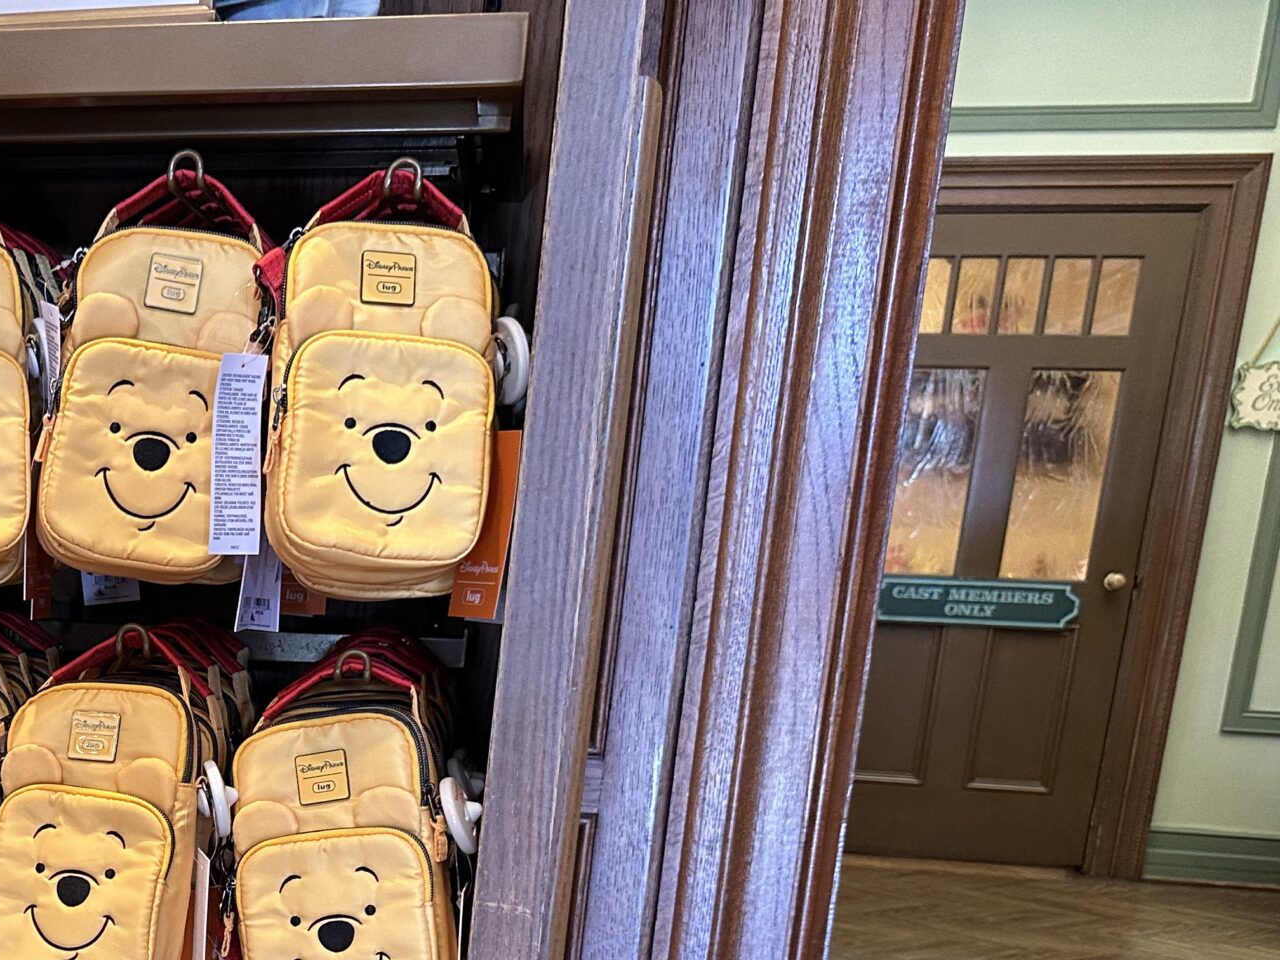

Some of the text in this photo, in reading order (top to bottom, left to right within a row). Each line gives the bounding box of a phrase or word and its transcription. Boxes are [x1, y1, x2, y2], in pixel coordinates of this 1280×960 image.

[382, 283, 397, 292] lug
[892, 584, 1054, 605] CAST MEMBERS
[944, 603, 996, 617] ONLY
[317, 783, 331, 791] lug
